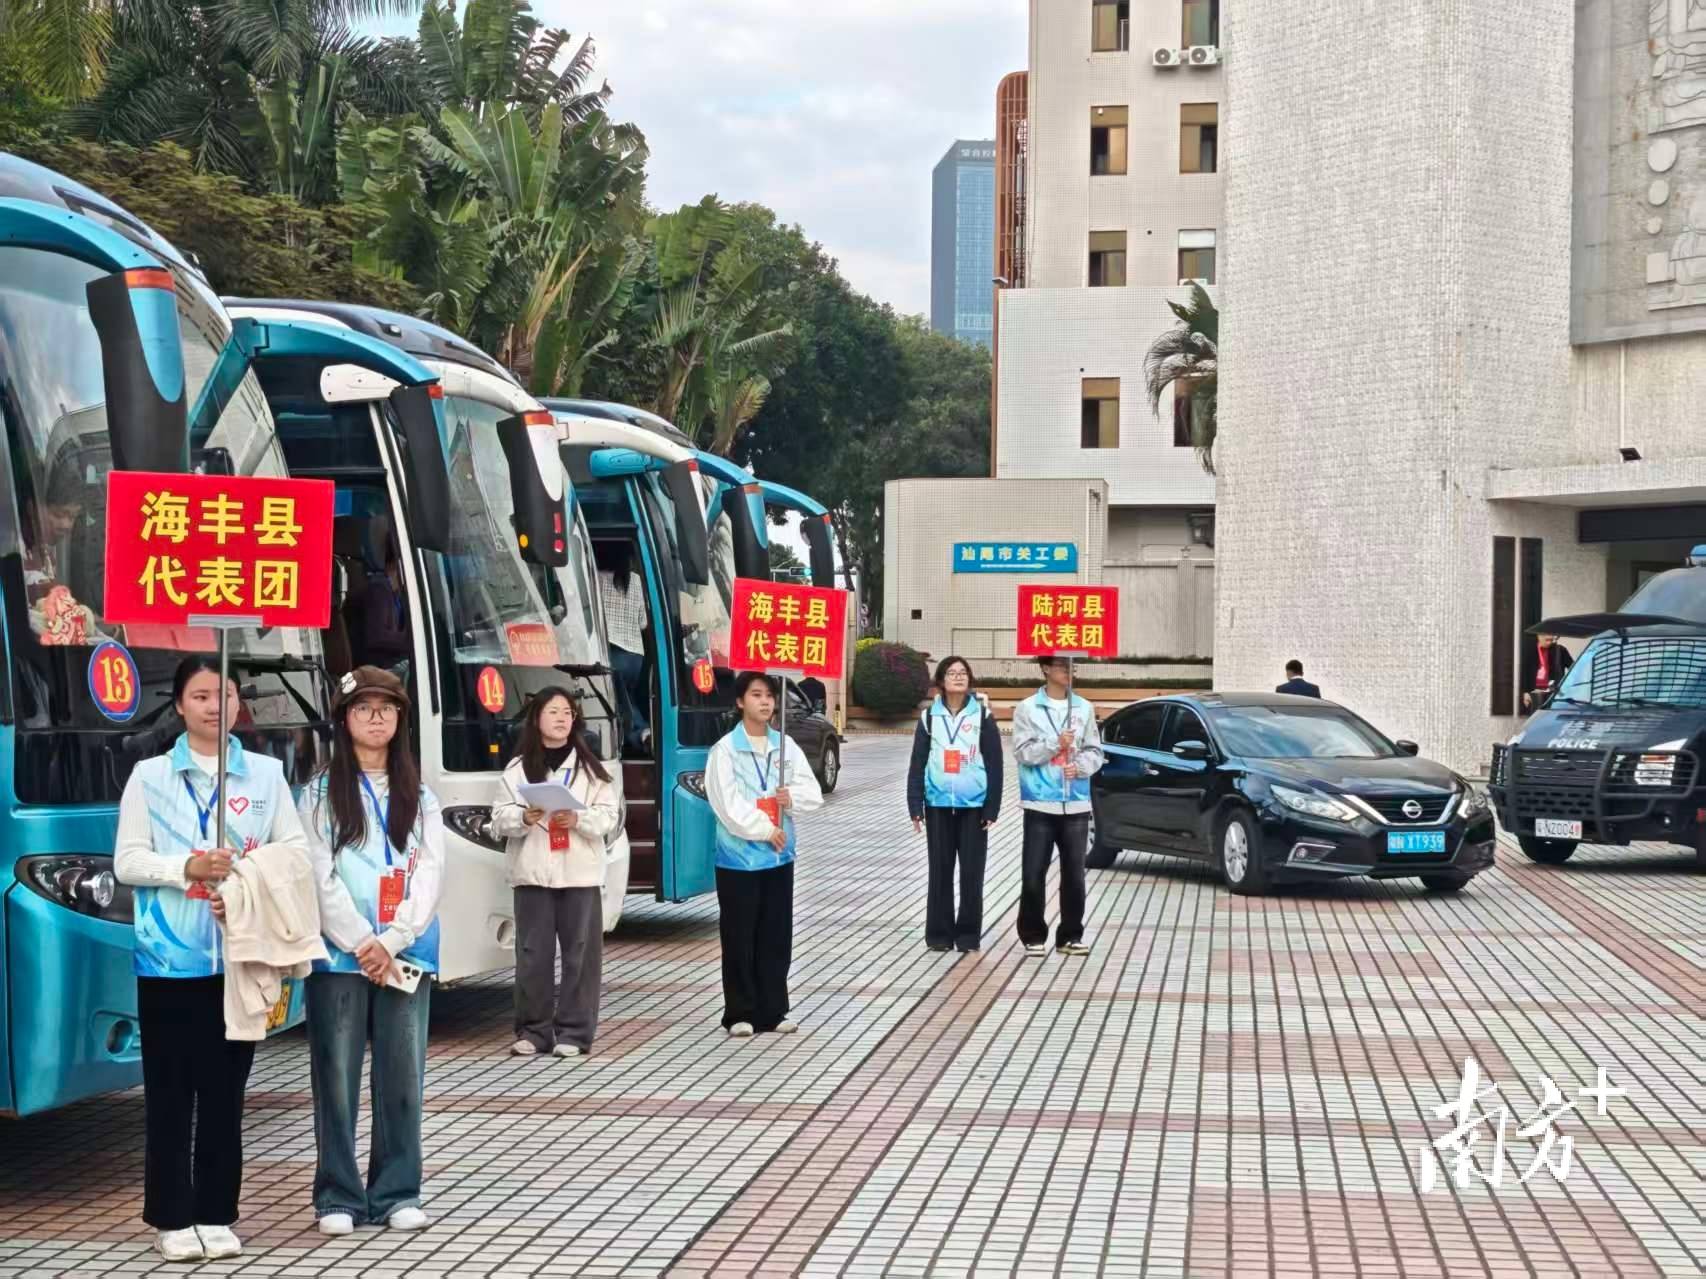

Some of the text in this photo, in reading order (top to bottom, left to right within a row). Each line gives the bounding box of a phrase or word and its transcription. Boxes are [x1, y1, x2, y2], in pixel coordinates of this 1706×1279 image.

[140, 491, 303, 547] 海丰县
[138, 555, 299, 609] 代表团
[748, 591, 830, 629] 海丰县
[1032, 593, 1106, 619] 陆河县
[746, 630, 828, 667] 代表团
[1031, 623, 1104, 648] 代表团
[99, 656, 132, 702] 13
[481, 672, 504, 706] 14
[697, 663, 713, 689] 15
[1547, 738, 1600, 750] POLICE
